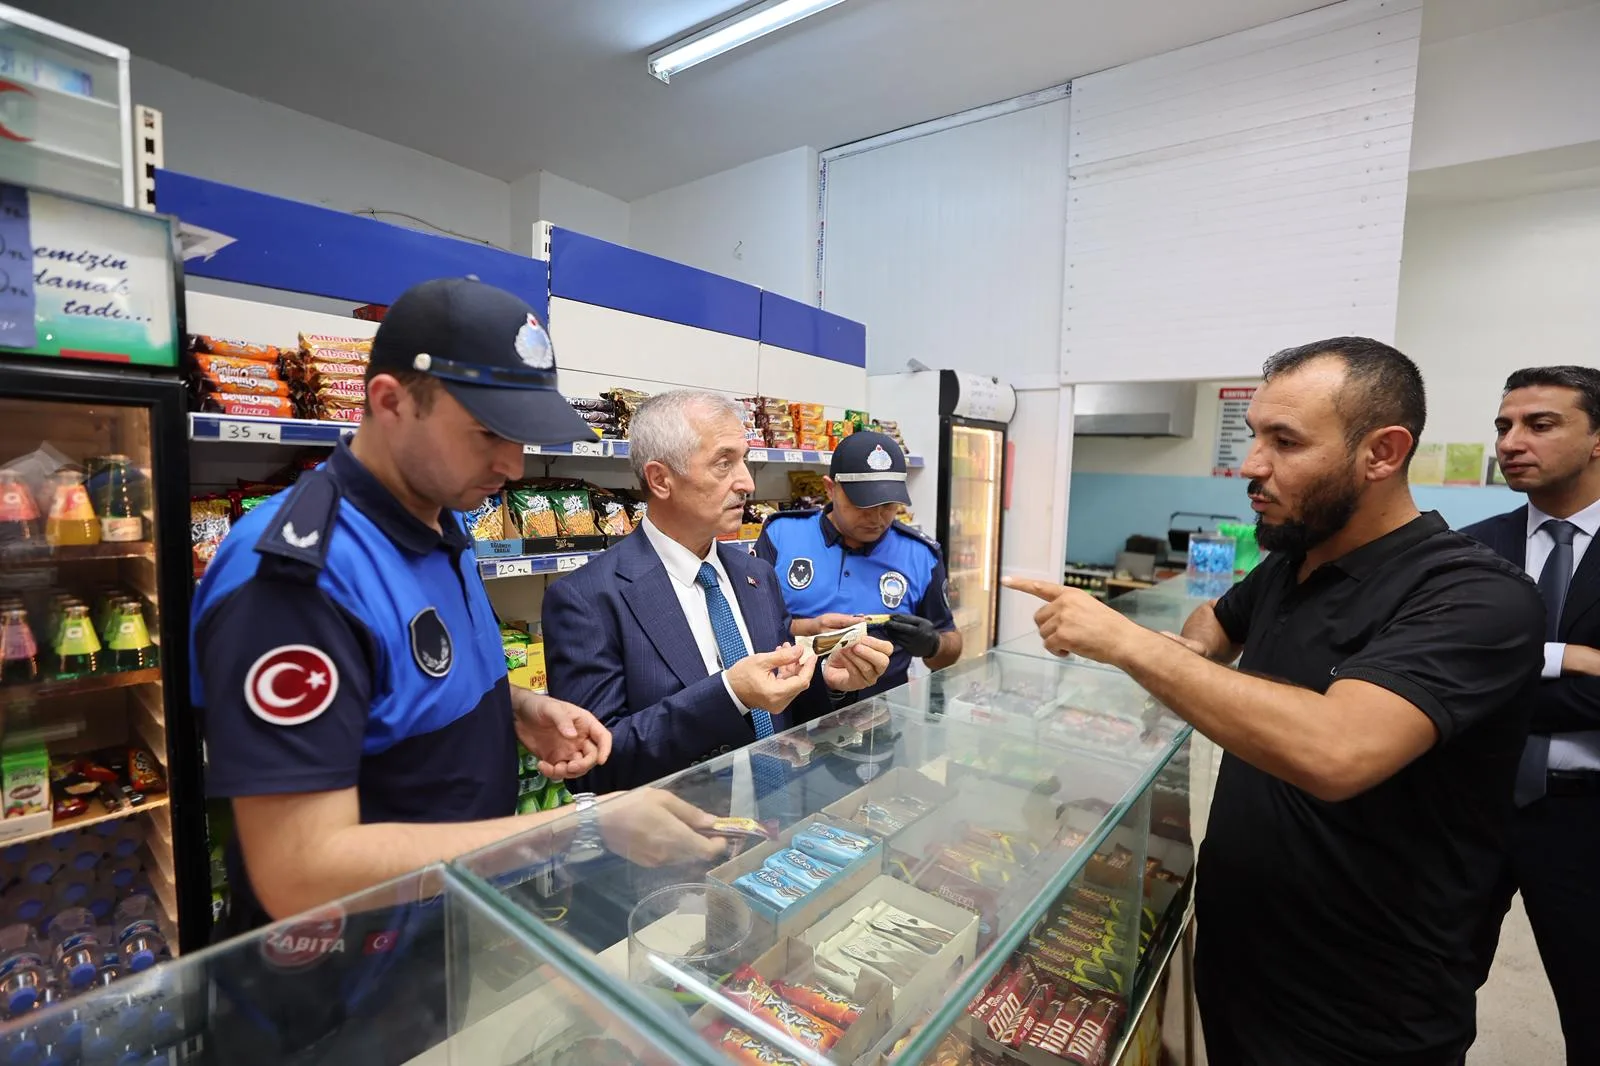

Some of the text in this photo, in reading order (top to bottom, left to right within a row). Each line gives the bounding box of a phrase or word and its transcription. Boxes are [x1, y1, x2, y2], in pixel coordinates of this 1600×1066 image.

[228, 425, 276, 441] 35 TL
[575, 442, 589, 455] 30
[499, 564, 515, 576] 20
[560, 558, 577, 570] 25
[265, 931, 345, 953] ZABITA
